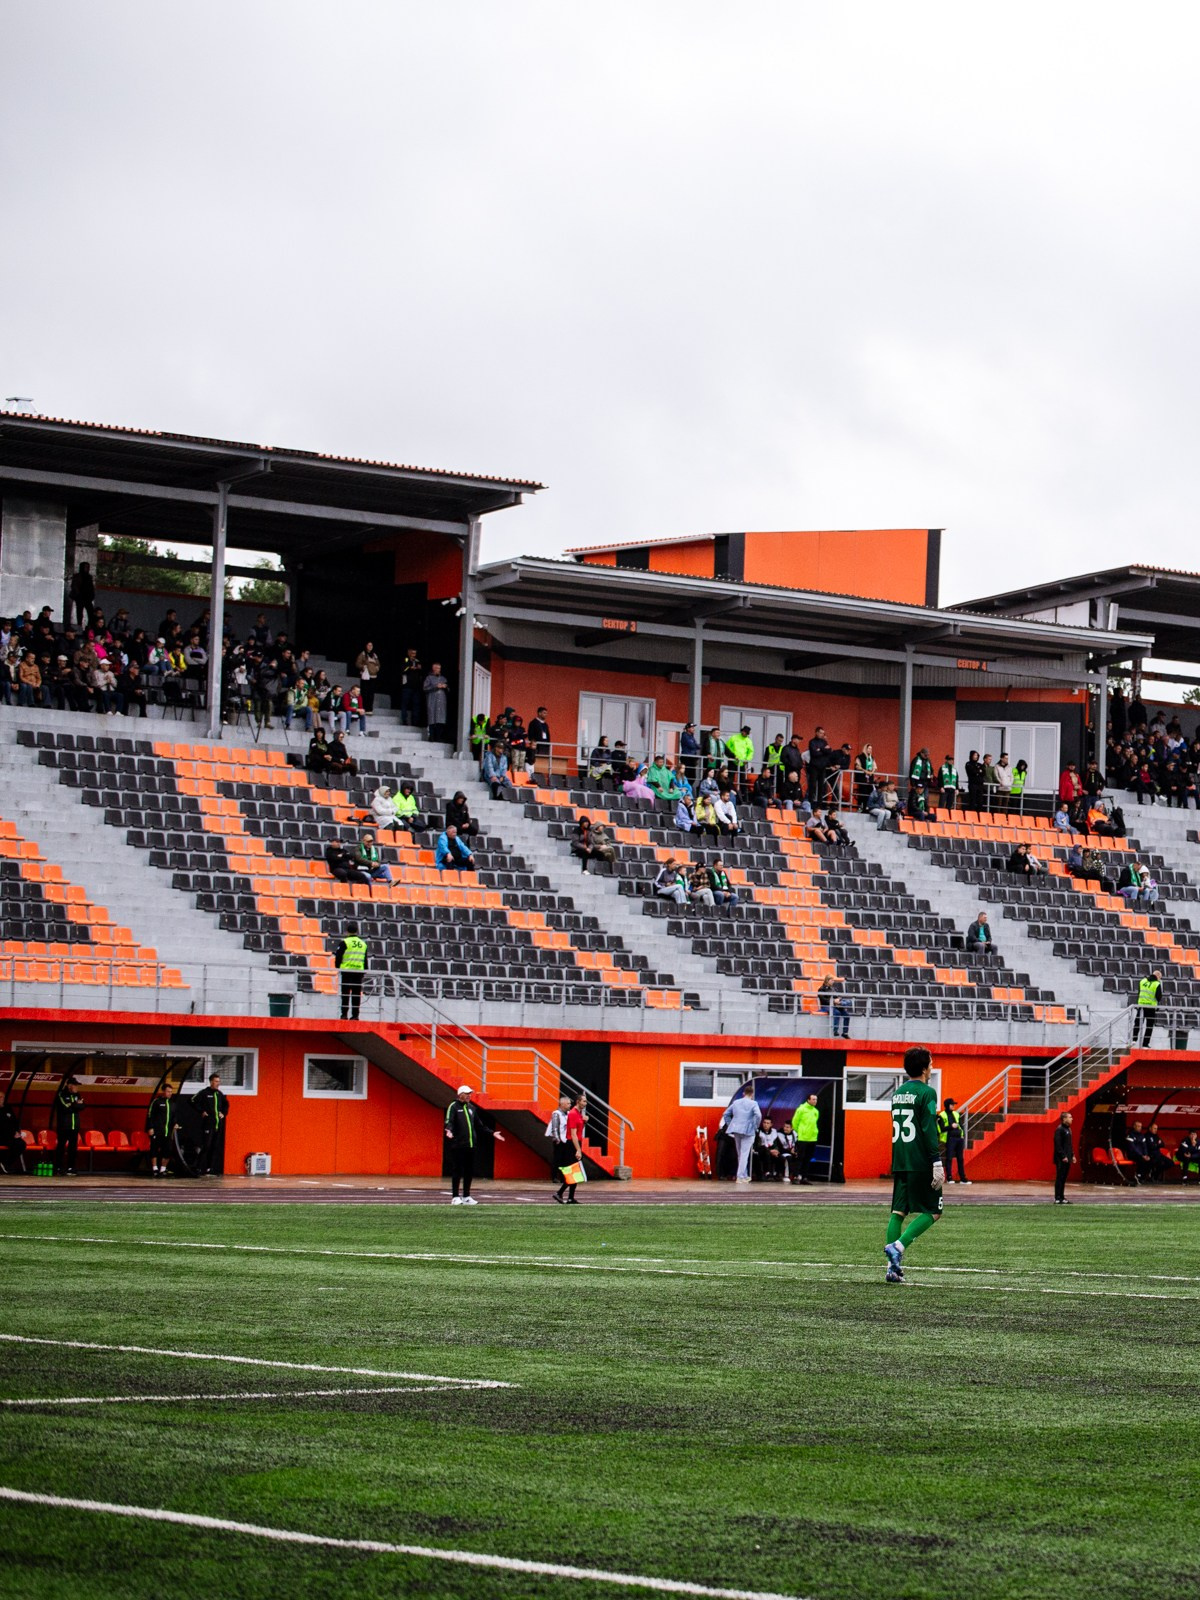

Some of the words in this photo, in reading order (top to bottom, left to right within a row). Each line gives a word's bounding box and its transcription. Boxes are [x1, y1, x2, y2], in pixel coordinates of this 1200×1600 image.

[603, 618, 628, 631] СЕКТОР
[630, 620, 637, 632] 3
[957, 659, 979, 670] СЕКТОР
[981, 661, 987, 671] 4
[351, 940, 363, 949] 36
[891, 1108, 917, 1143] 53
